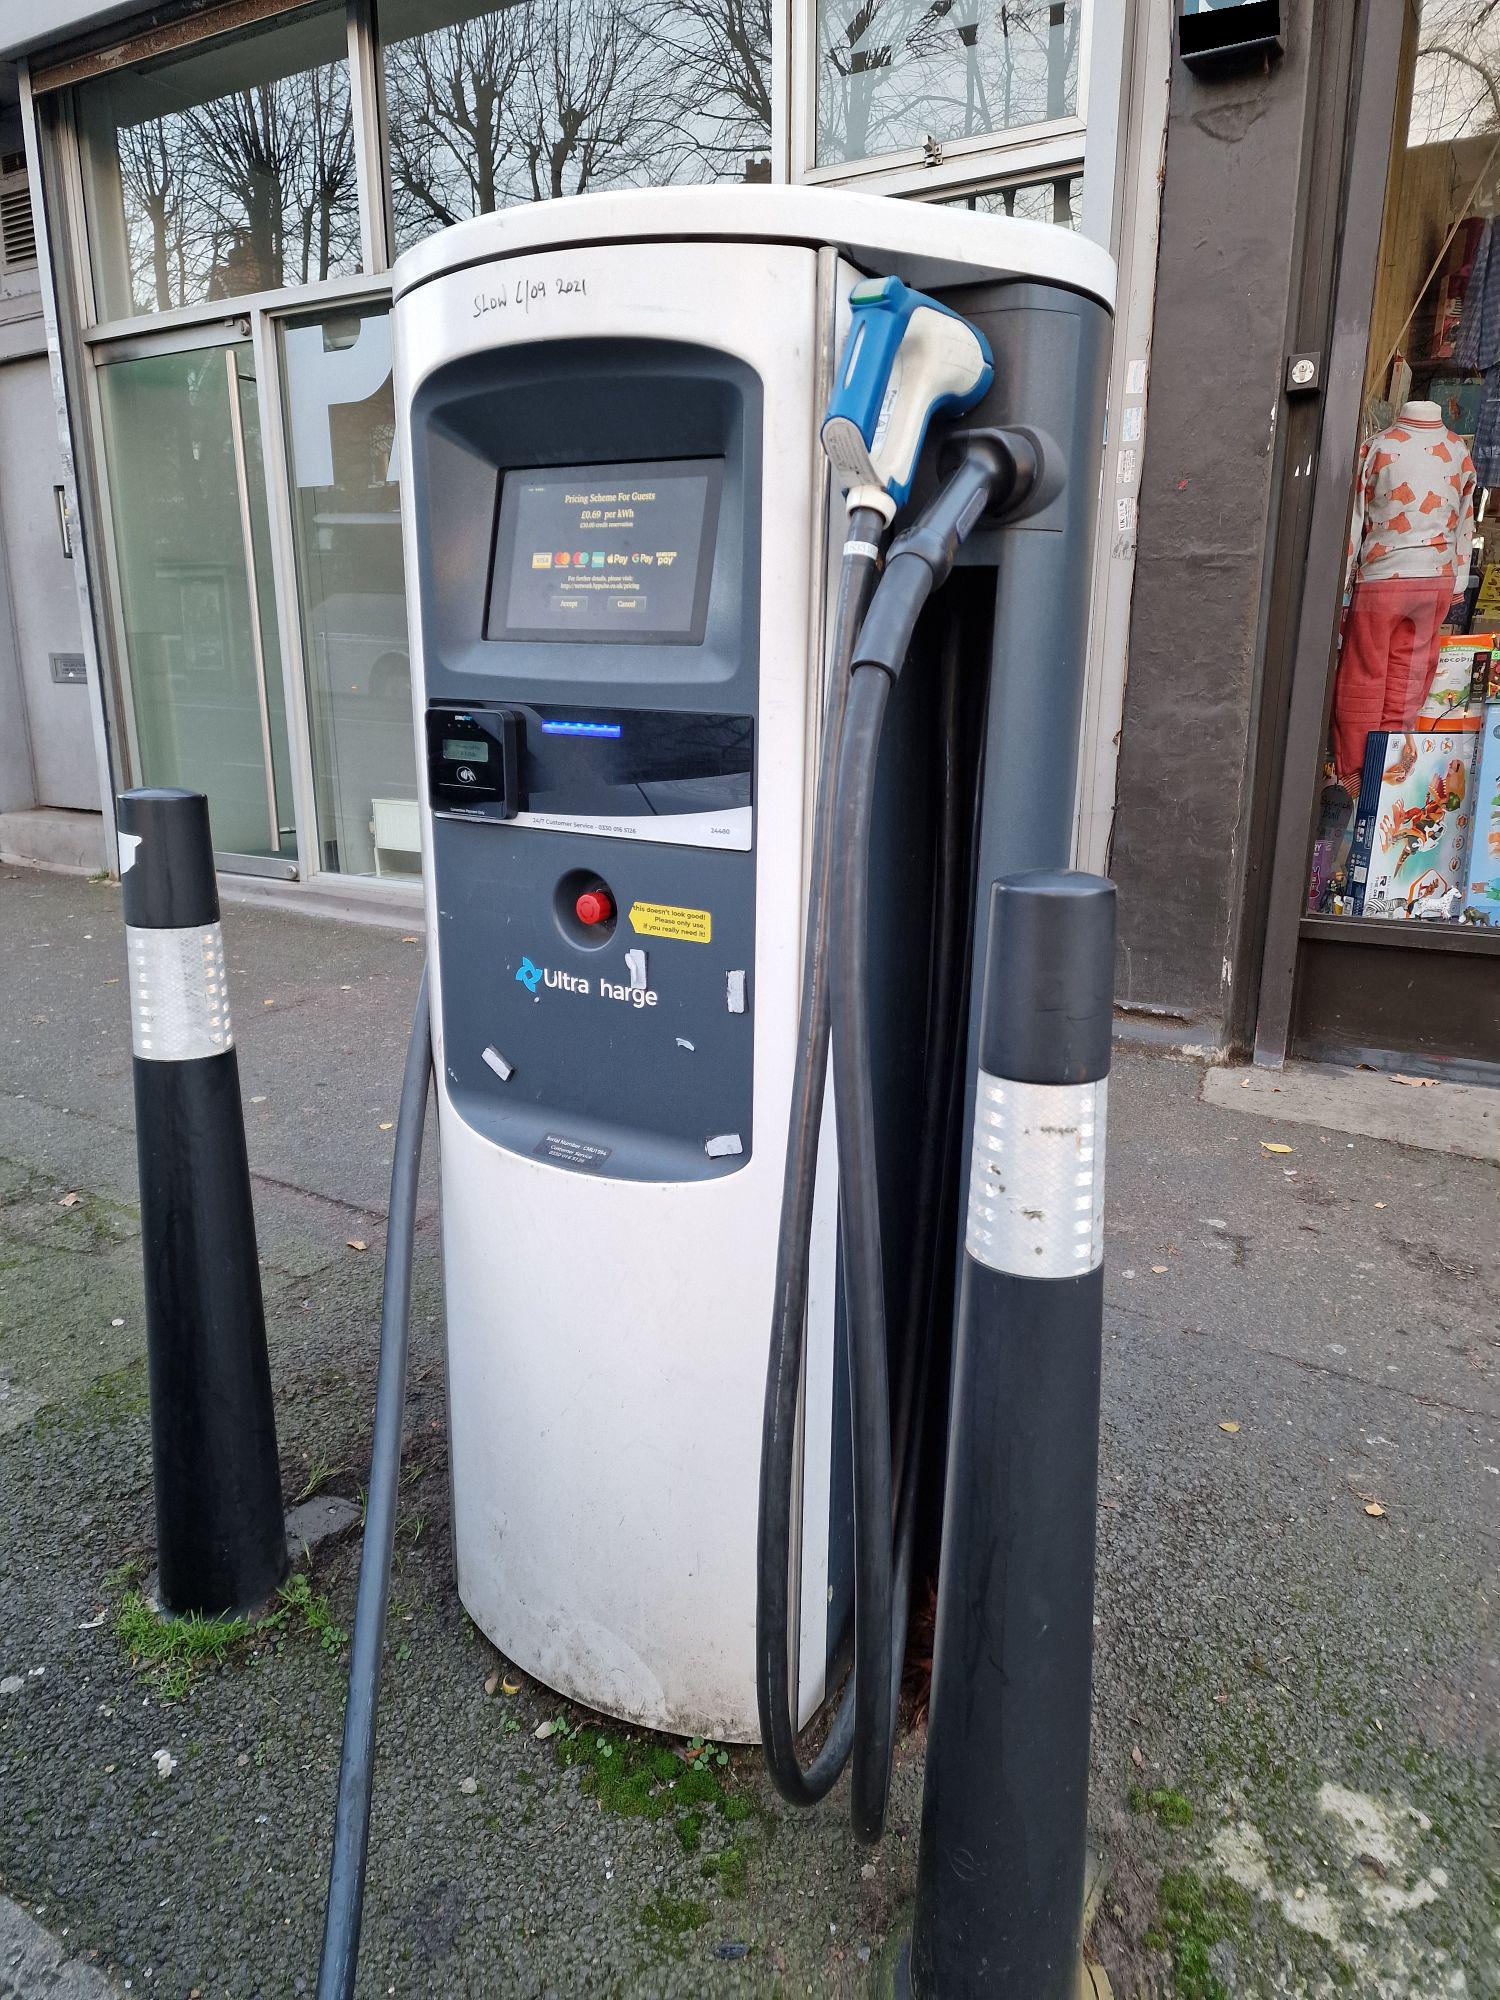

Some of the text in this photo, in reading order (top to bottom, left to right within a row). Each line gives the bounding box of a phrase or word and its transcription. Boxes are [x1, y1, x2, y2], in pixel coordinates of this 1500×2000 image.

[473, 284, 507, 318] SLOW
[556, 278, 586, 297] 2021
[564, 491, 656, 505] Pricing Scheme For Guests
[580, 508, 634, 521] £0.69 per kWh
[613, 553, 629, 566] Pay
[640, 553, 654, 565] Pay
[657, 557, 674, 566] pay
[560, 600, 578, 609] Accept
[617, 600, 636, 608] Cancel
[1439, 656, 1474, 664] ROCODIL
[545, 818, 572, 827] Customer
[573, 821, 594, 829] Service
[632, 904, 706, 921] this doesn't look good!
[654, 916, 676, 925] Please
[676, 920, 691, 928] only
[661, 925, 680, 934] really
[680, 928, 698, 936] need
[543, 968, 589, 994] Ultra
[545, 1136, 561, 1144] Serial
[560, 1139, 581, 1149] Number
